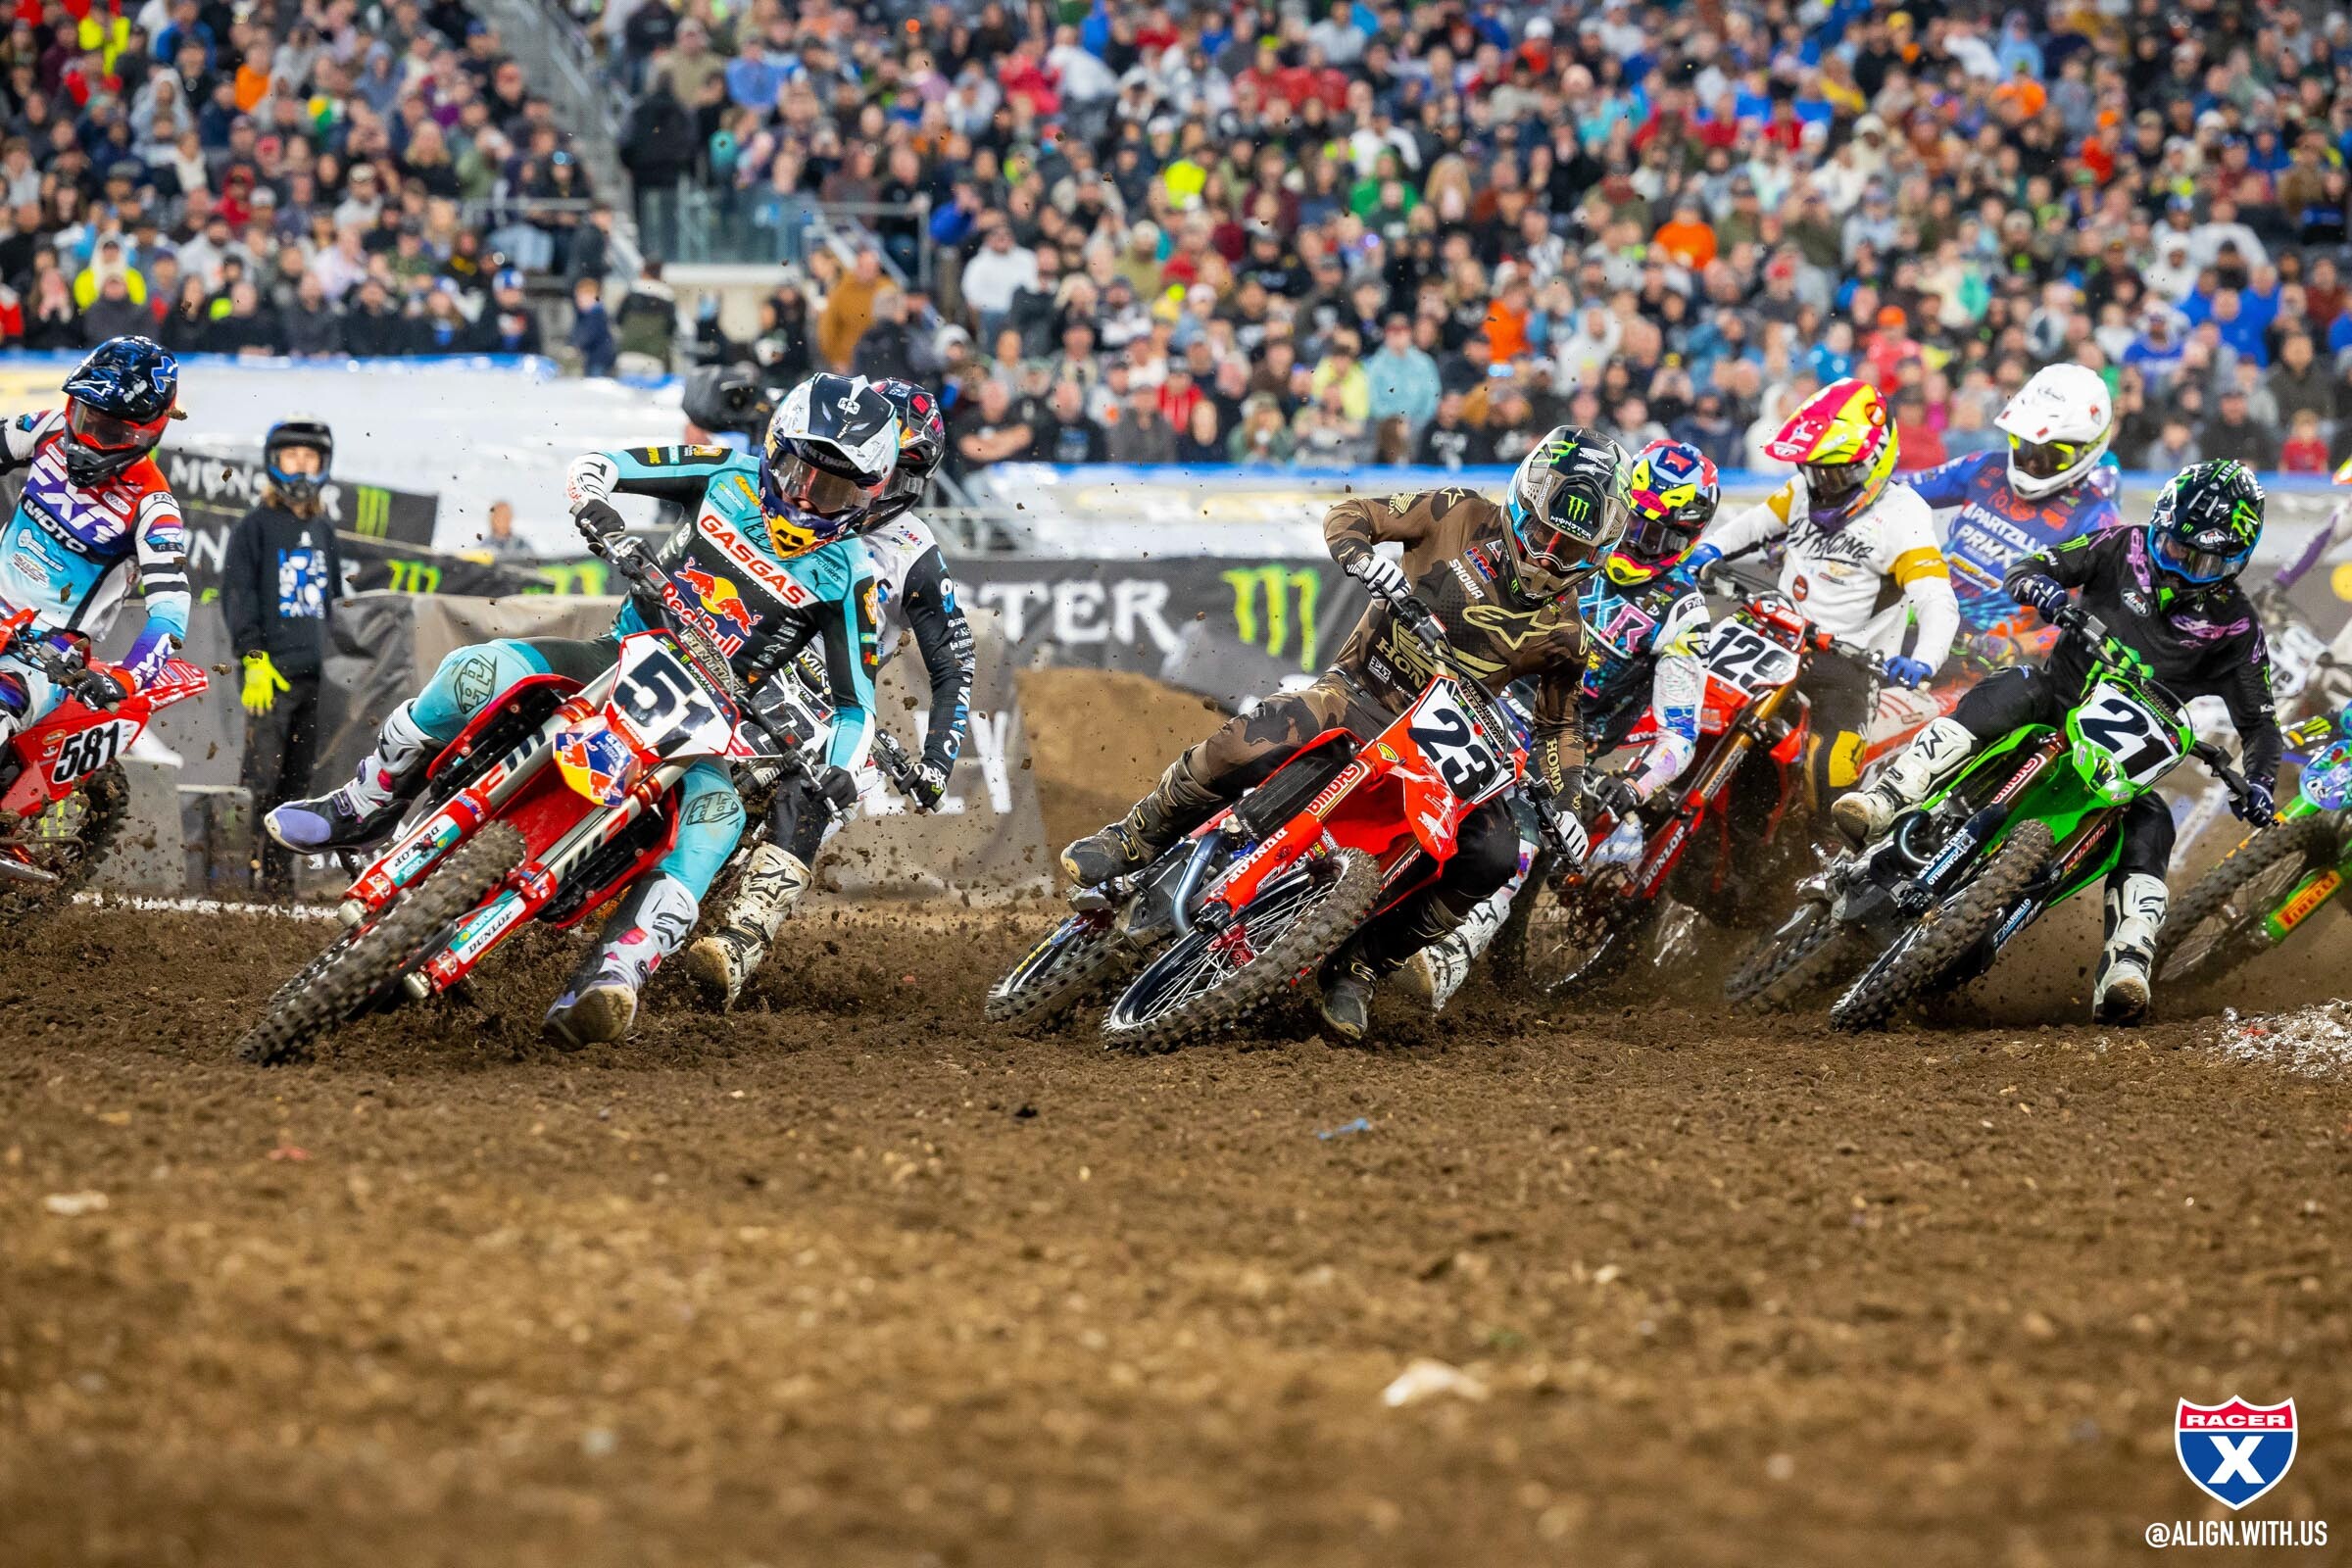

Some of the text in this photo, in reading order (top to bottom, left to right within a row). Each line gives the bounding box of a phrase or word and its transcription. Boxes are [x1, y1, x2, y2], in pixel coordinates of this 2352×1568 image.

[24, 499, 88, 553] MOTO
[1549, 515, 1592, 539] MONSTER
[1955, 524, 2024, 569] PRMX
[2199, 531, 2226, 545] Airoh
[700, 514, 806, 605] GASGAS
[811, 554, 840, 582] PICTURES
[1448, 559, 1485, 599] SHOWA
[1464, 547, 1497, 582] HRC
[662, 582, 745, 659] Red Bull
[1709, 626, 1790, 689] 129
[612, 650, 715, 760] 51
[55, 721, 121, 783] 581
[1407, 708, 1497, 800] 23
[2079, 698, 2173, 780] 21
[1306, 764, 1362, 816] SHOWA
[1227, 827, 1290, 885] DUNLOP
[1642, 825, 1685, 889] DUNLOP
[1917, 828, 1969, 880] DUNLOP
[1926, 852, 1959, 886] CARRILLO
[2003, 897, 2033, 932] CARRILLO
[2282, 875, 2335, 926] PIRELLI
[466, 910, 514, 956] DUNLOP
